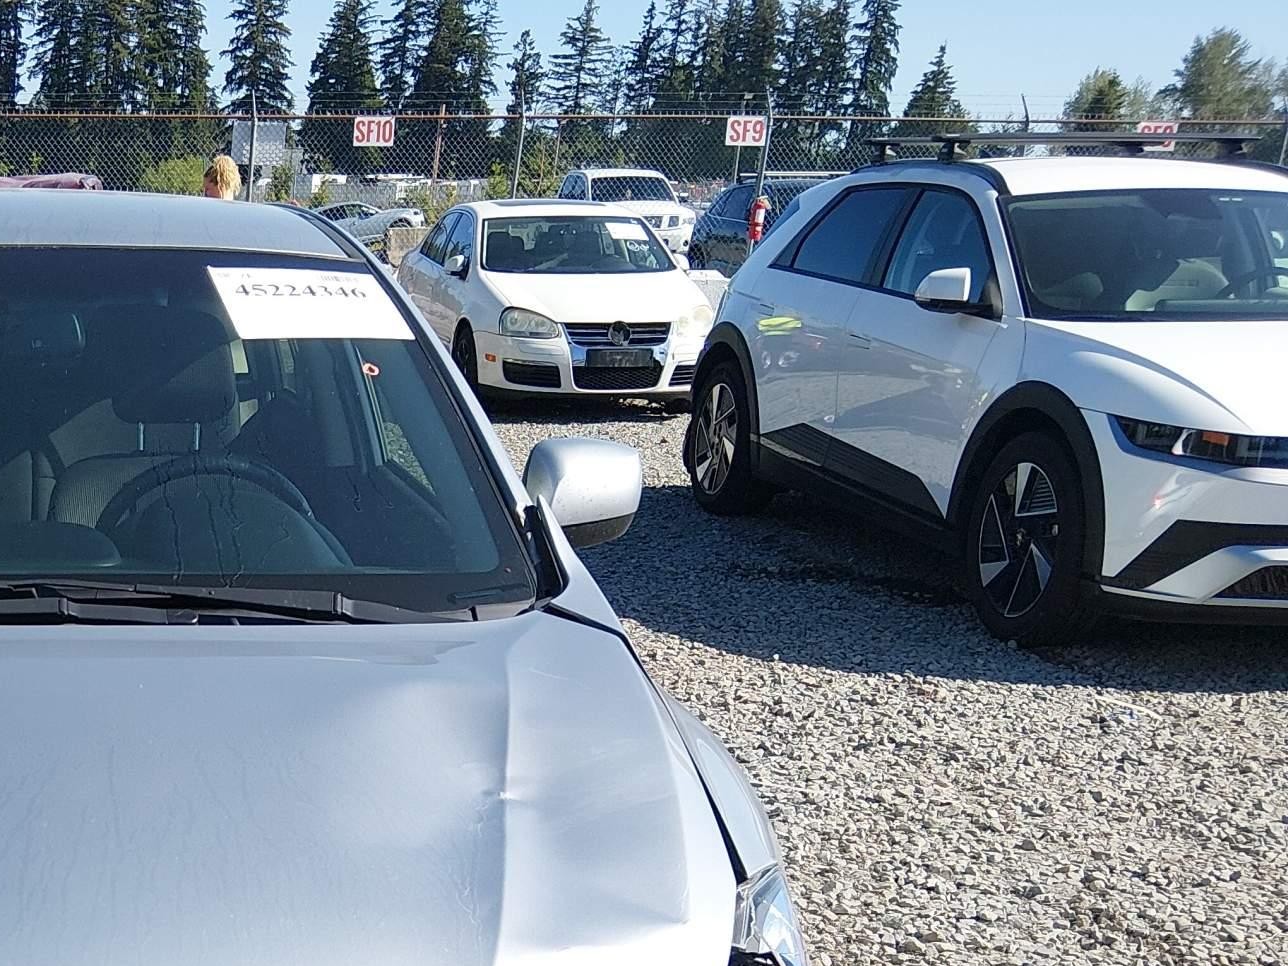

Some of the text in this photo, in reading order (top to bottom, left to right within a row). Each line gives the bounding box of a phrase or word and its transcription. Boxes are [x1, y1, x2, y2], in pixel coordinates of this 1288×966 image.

[355, 120, 393, 143] SF10
[729, 119, 764, 142] SF9
[235, 283, 367, 299] 45224346
